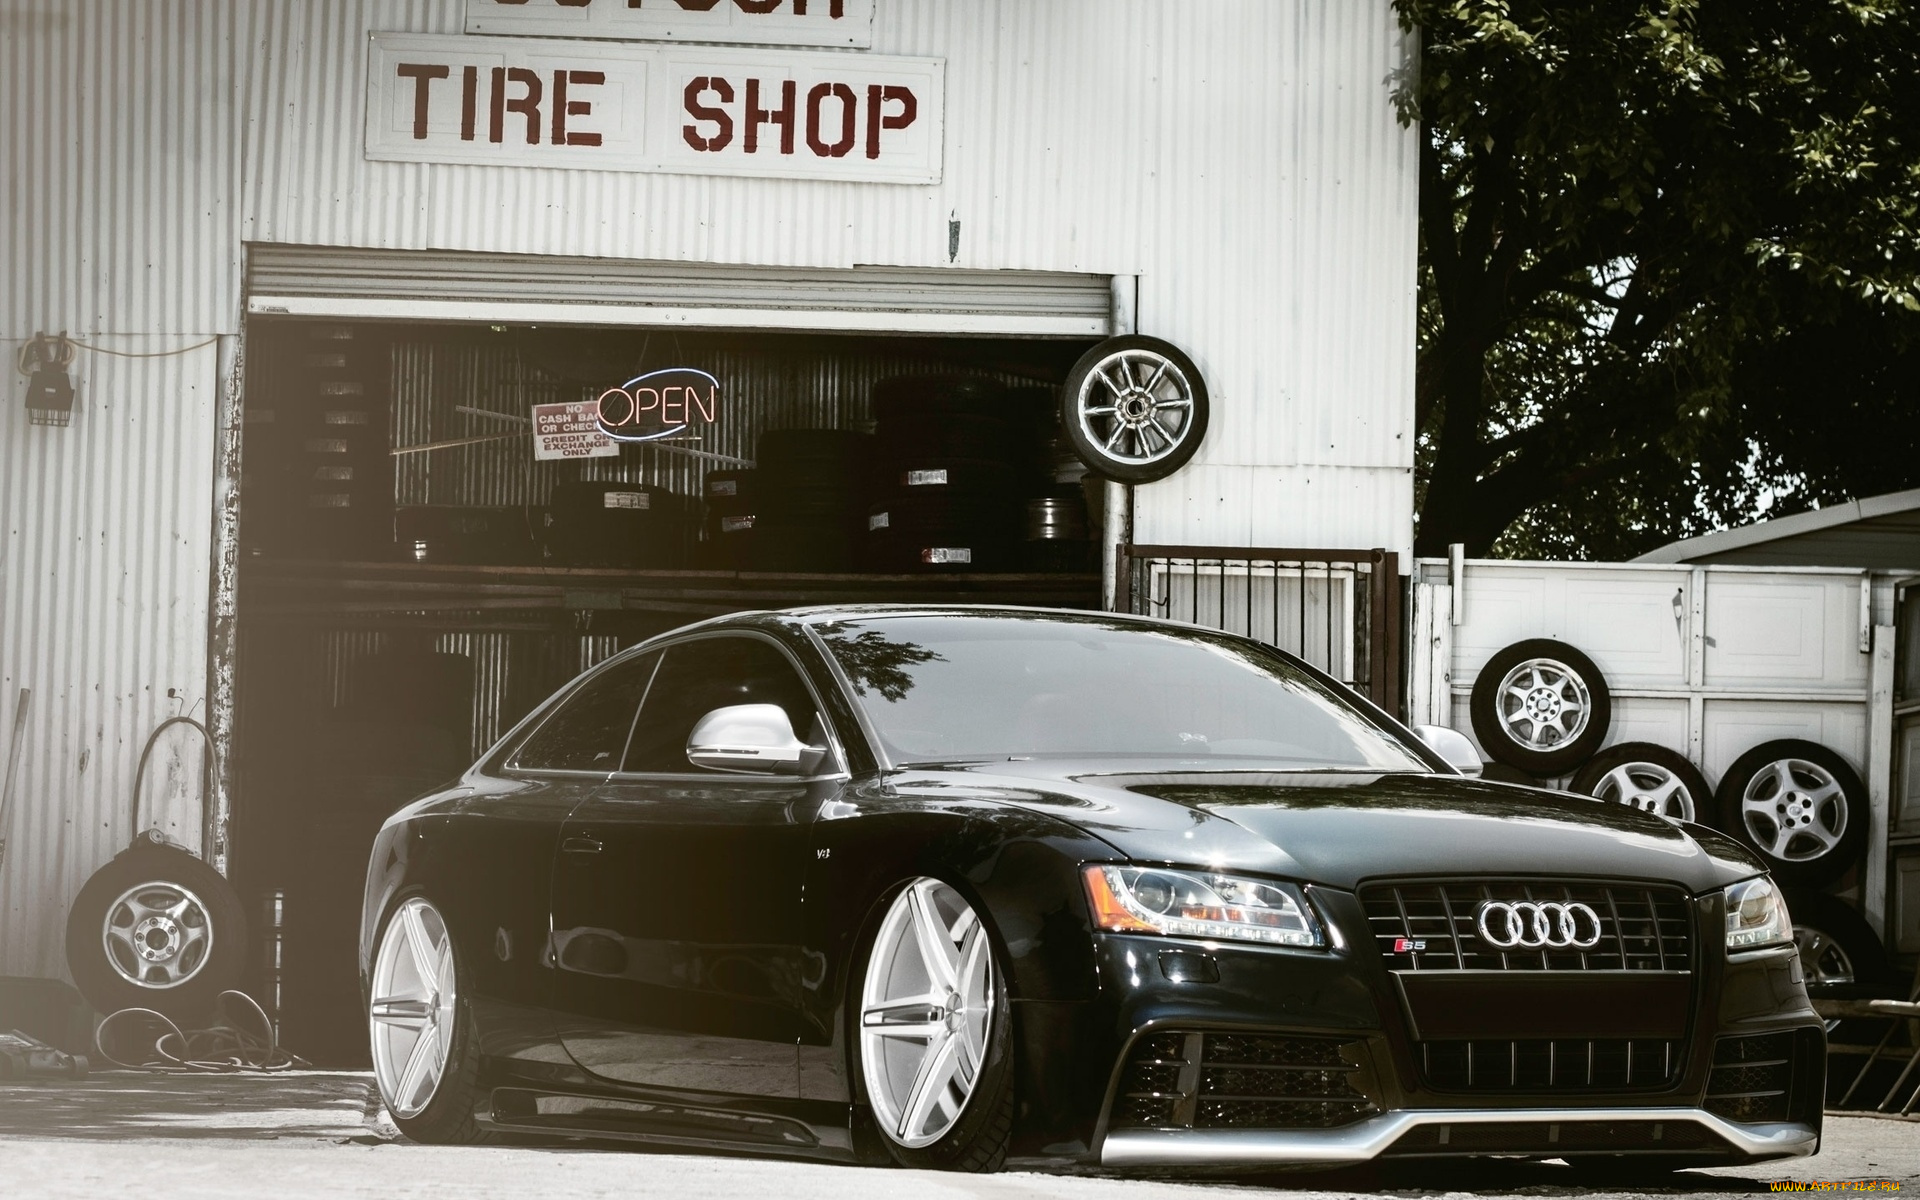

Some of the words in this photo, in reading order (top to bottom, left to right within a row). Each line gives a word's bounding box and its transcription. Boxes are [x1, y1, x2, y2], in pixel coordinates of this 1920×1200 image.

[397, 63, 605, 146] TIRE
[683, 76, 917, 159] SHOP
[565, 405, 582, 414] NO
[597, 385, 715, 426] OPEN
[539, 414, 571, 424] CASH
[577, 412, 600, 422] BAC
[541, 424, 557, 433] OR
[543, 435, 587, 443] CREDIT
[594, 433, 610, 441] OR
[544, 440, 610, 451] EXCHANGE
[563, 448, 592, 456] ONLY
[1402, 941, 1426, 950] S5
